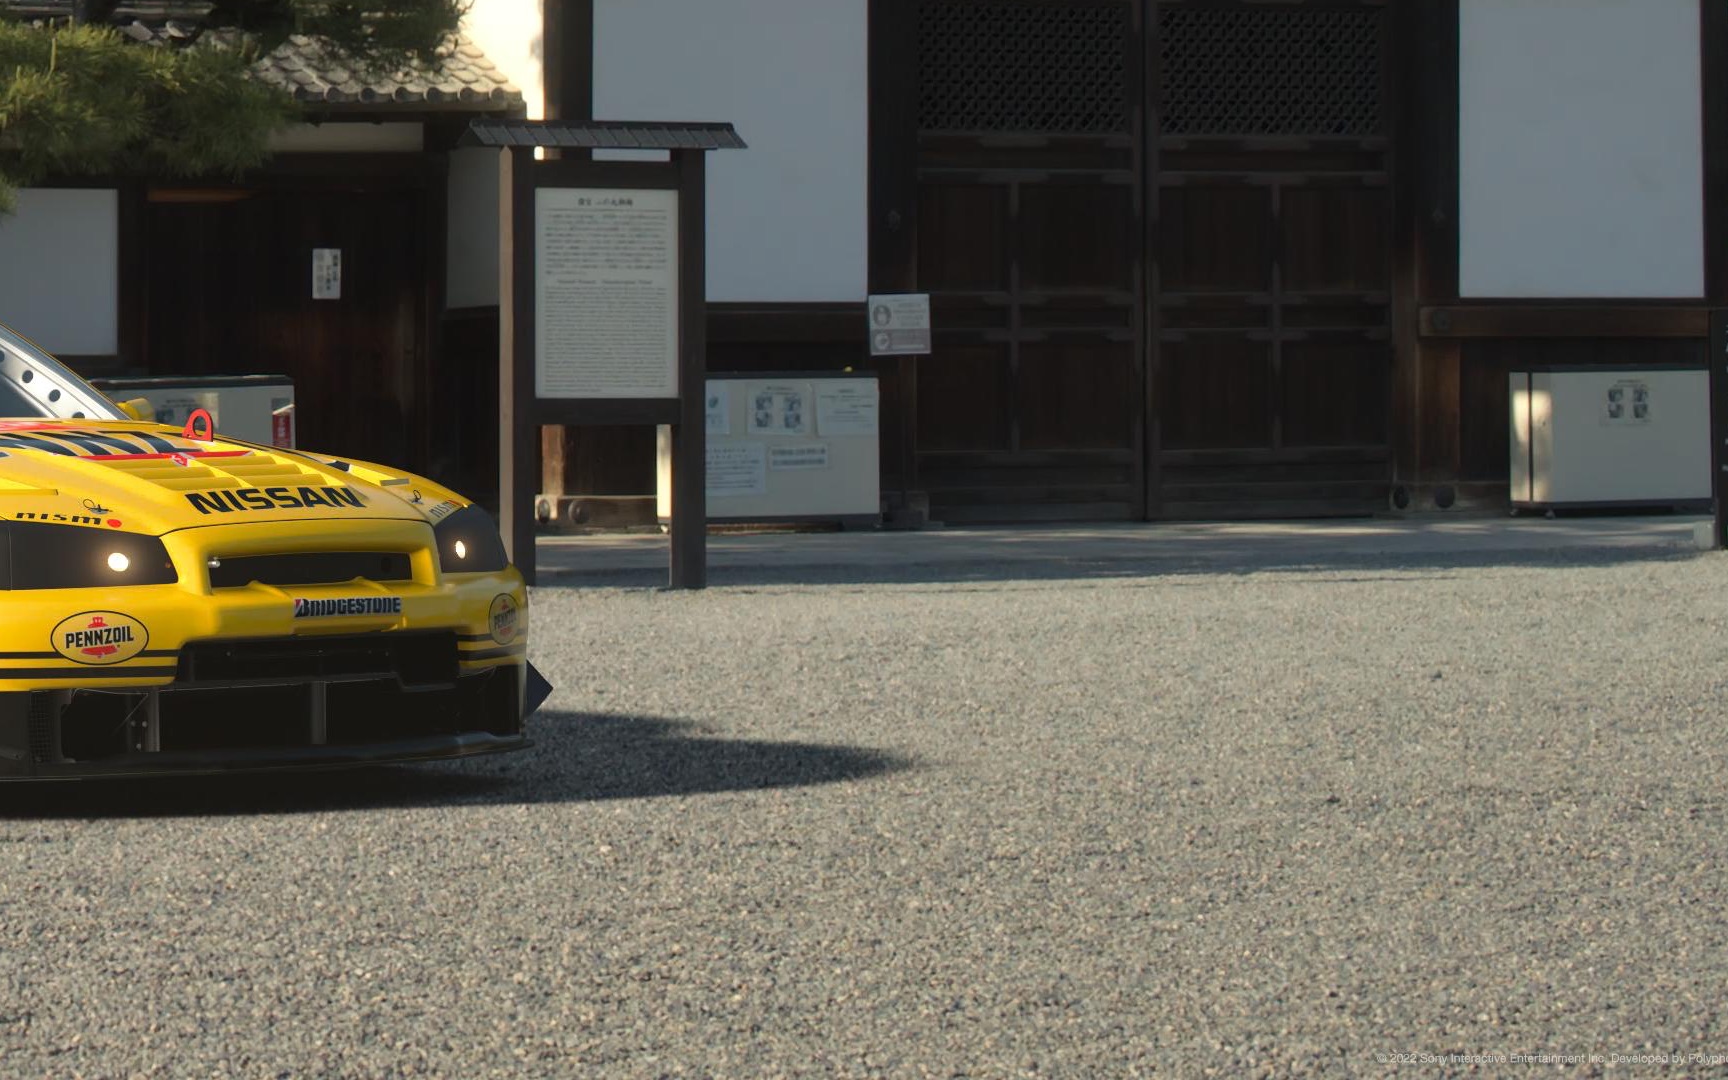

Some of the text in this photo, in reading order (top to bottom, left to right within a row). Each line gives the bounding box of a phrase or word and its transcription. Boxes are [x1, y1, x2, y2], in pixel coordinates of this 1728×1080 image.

[184, 487, 367, 515] NISSAN
[294, 597, 401, 617] BRIDGESTONE
[65, 626, 134, 648] PENNZOIL
